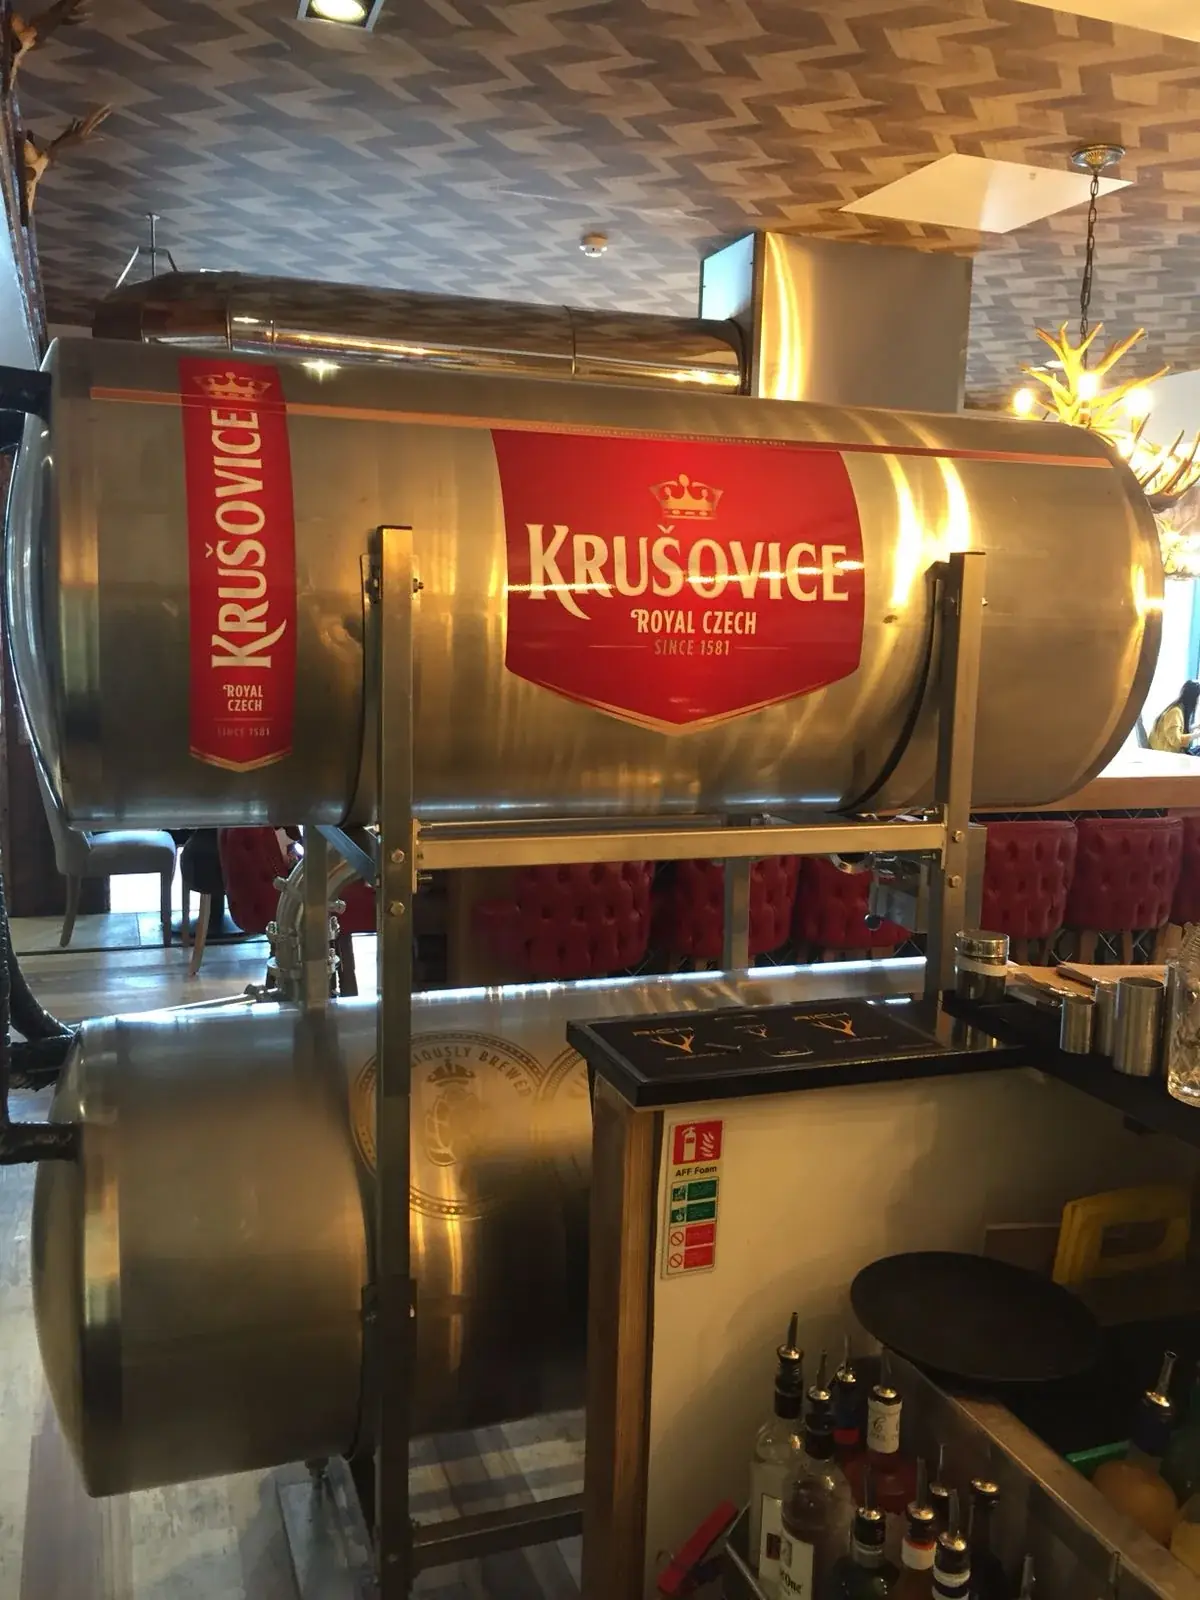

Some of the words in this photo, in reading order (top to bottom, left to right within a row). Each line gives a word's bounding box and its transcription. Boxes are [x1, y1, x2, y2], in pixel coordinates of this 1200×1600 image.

[205, 408, 287, 669] KRUŠOVICE
[525, 523, 850, 620] KRUŠOVICE
[629, 608, 696, 634] ROYAL
[702, 610, 757, 635] CZECH
[653, 638, 694, 656] SINCE
[700, 639, 730, 656] 1581
[222, 684, 264, 698] ROYAL
[227, 699, 263, 712] CZECH
[478, 1050, 532, 1097] BREWED
[694, 1166, 718, 1175] Foam
